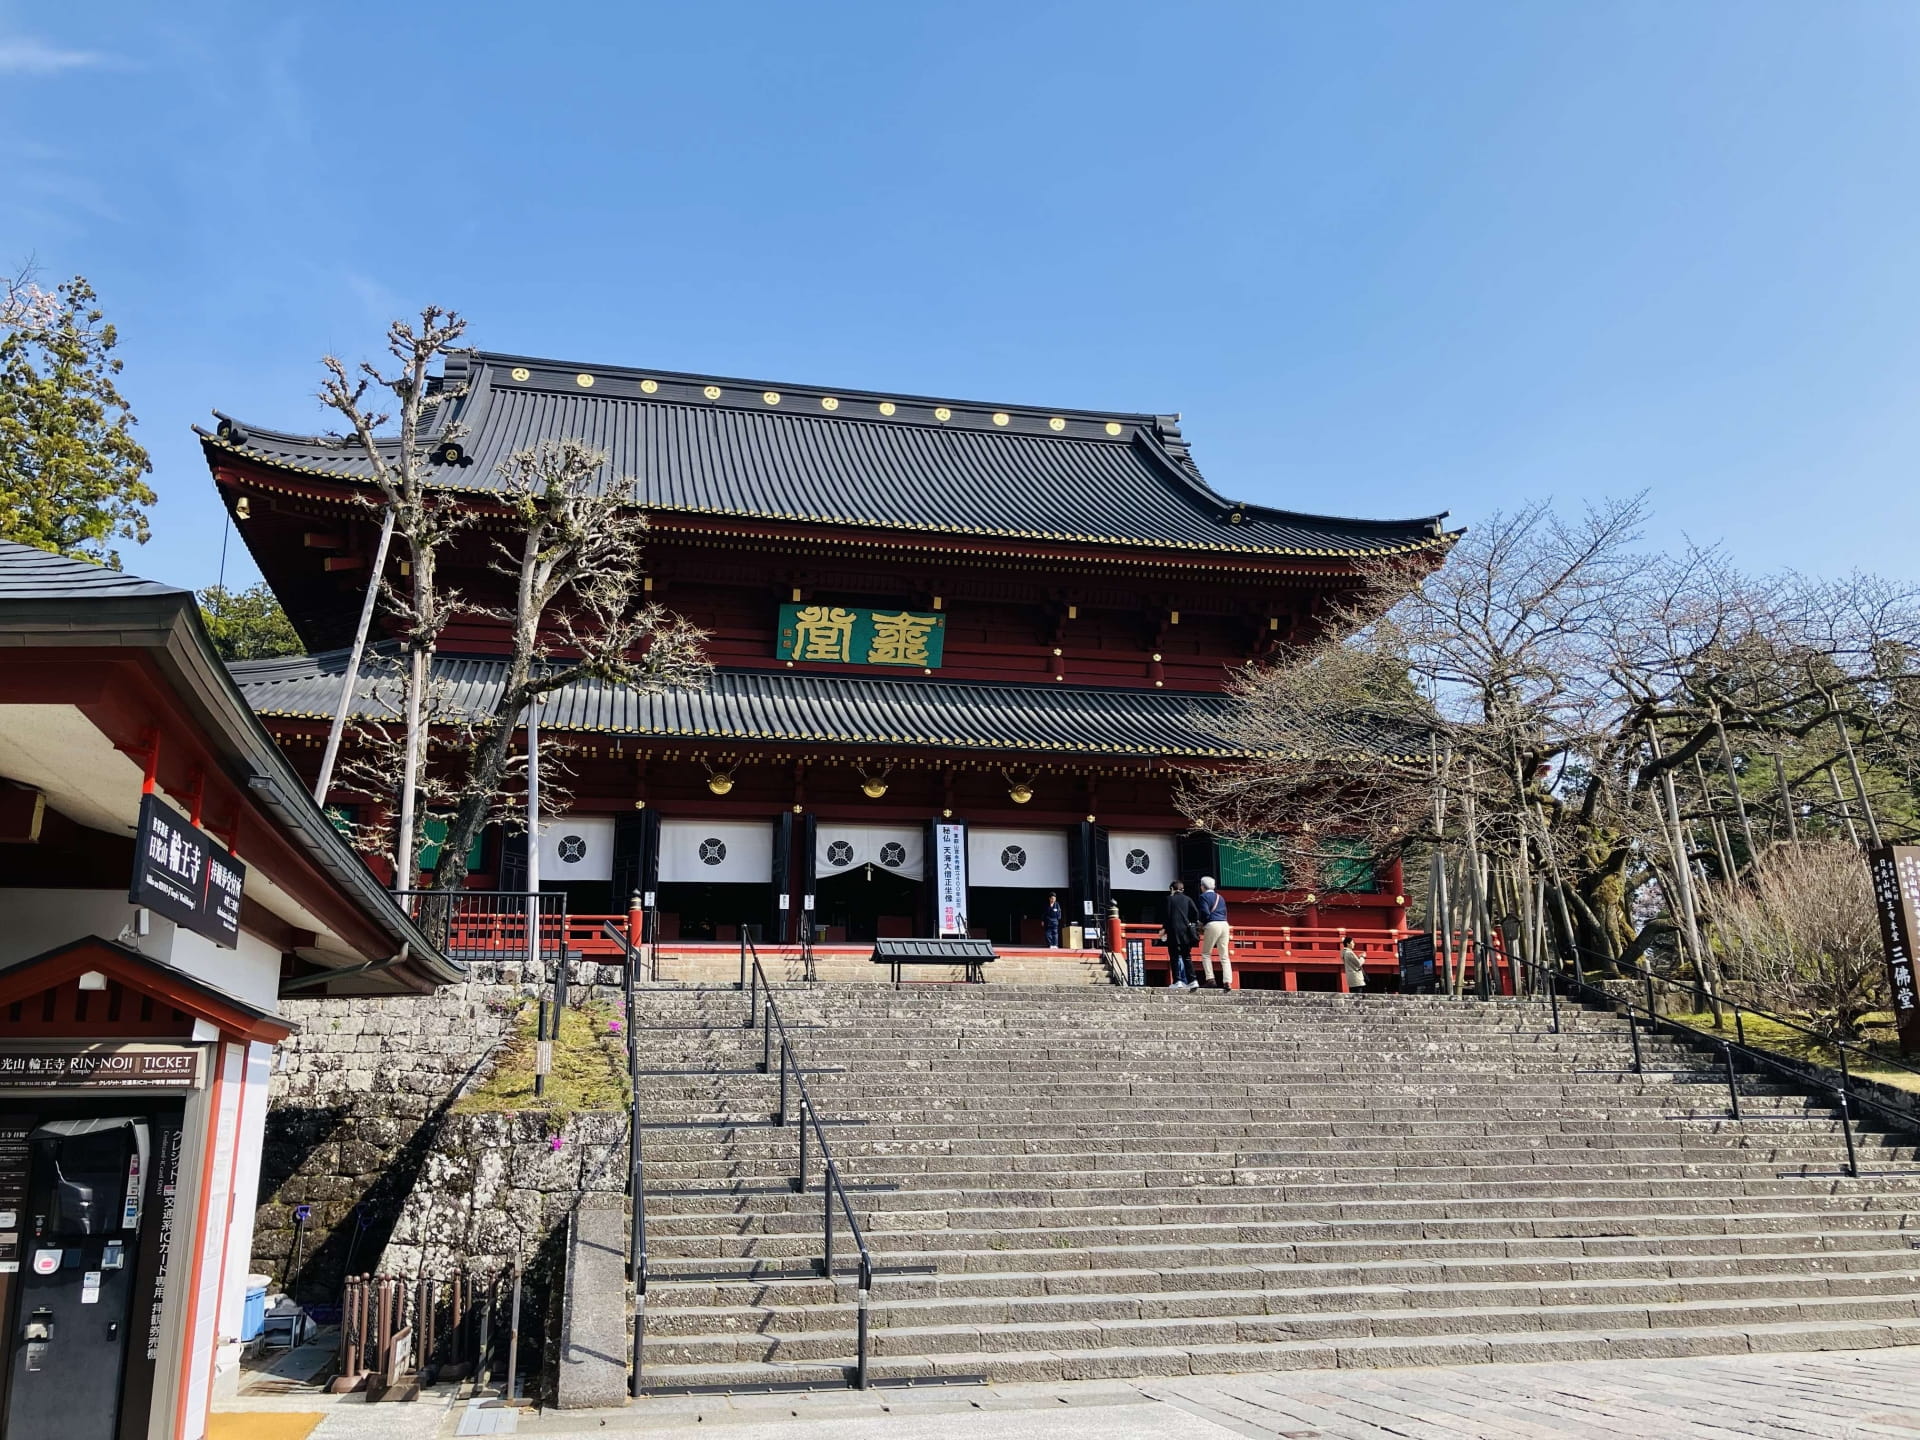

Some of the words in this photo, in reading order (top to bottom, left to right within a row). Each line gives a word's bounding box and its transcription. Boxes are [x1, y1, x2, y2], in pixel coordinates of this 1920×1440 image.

[149, 834, 168, 866] 日光山
[169, 829, 201, 885] 輪王寺
[1891, 945, 1915, 1010] 三佛堂
[28, 1058, 66, 1070] 輪王寺
[70, 1056, 133, 1070] RIN-NOJI
[143, 1056, 192, 1069] TICKET
